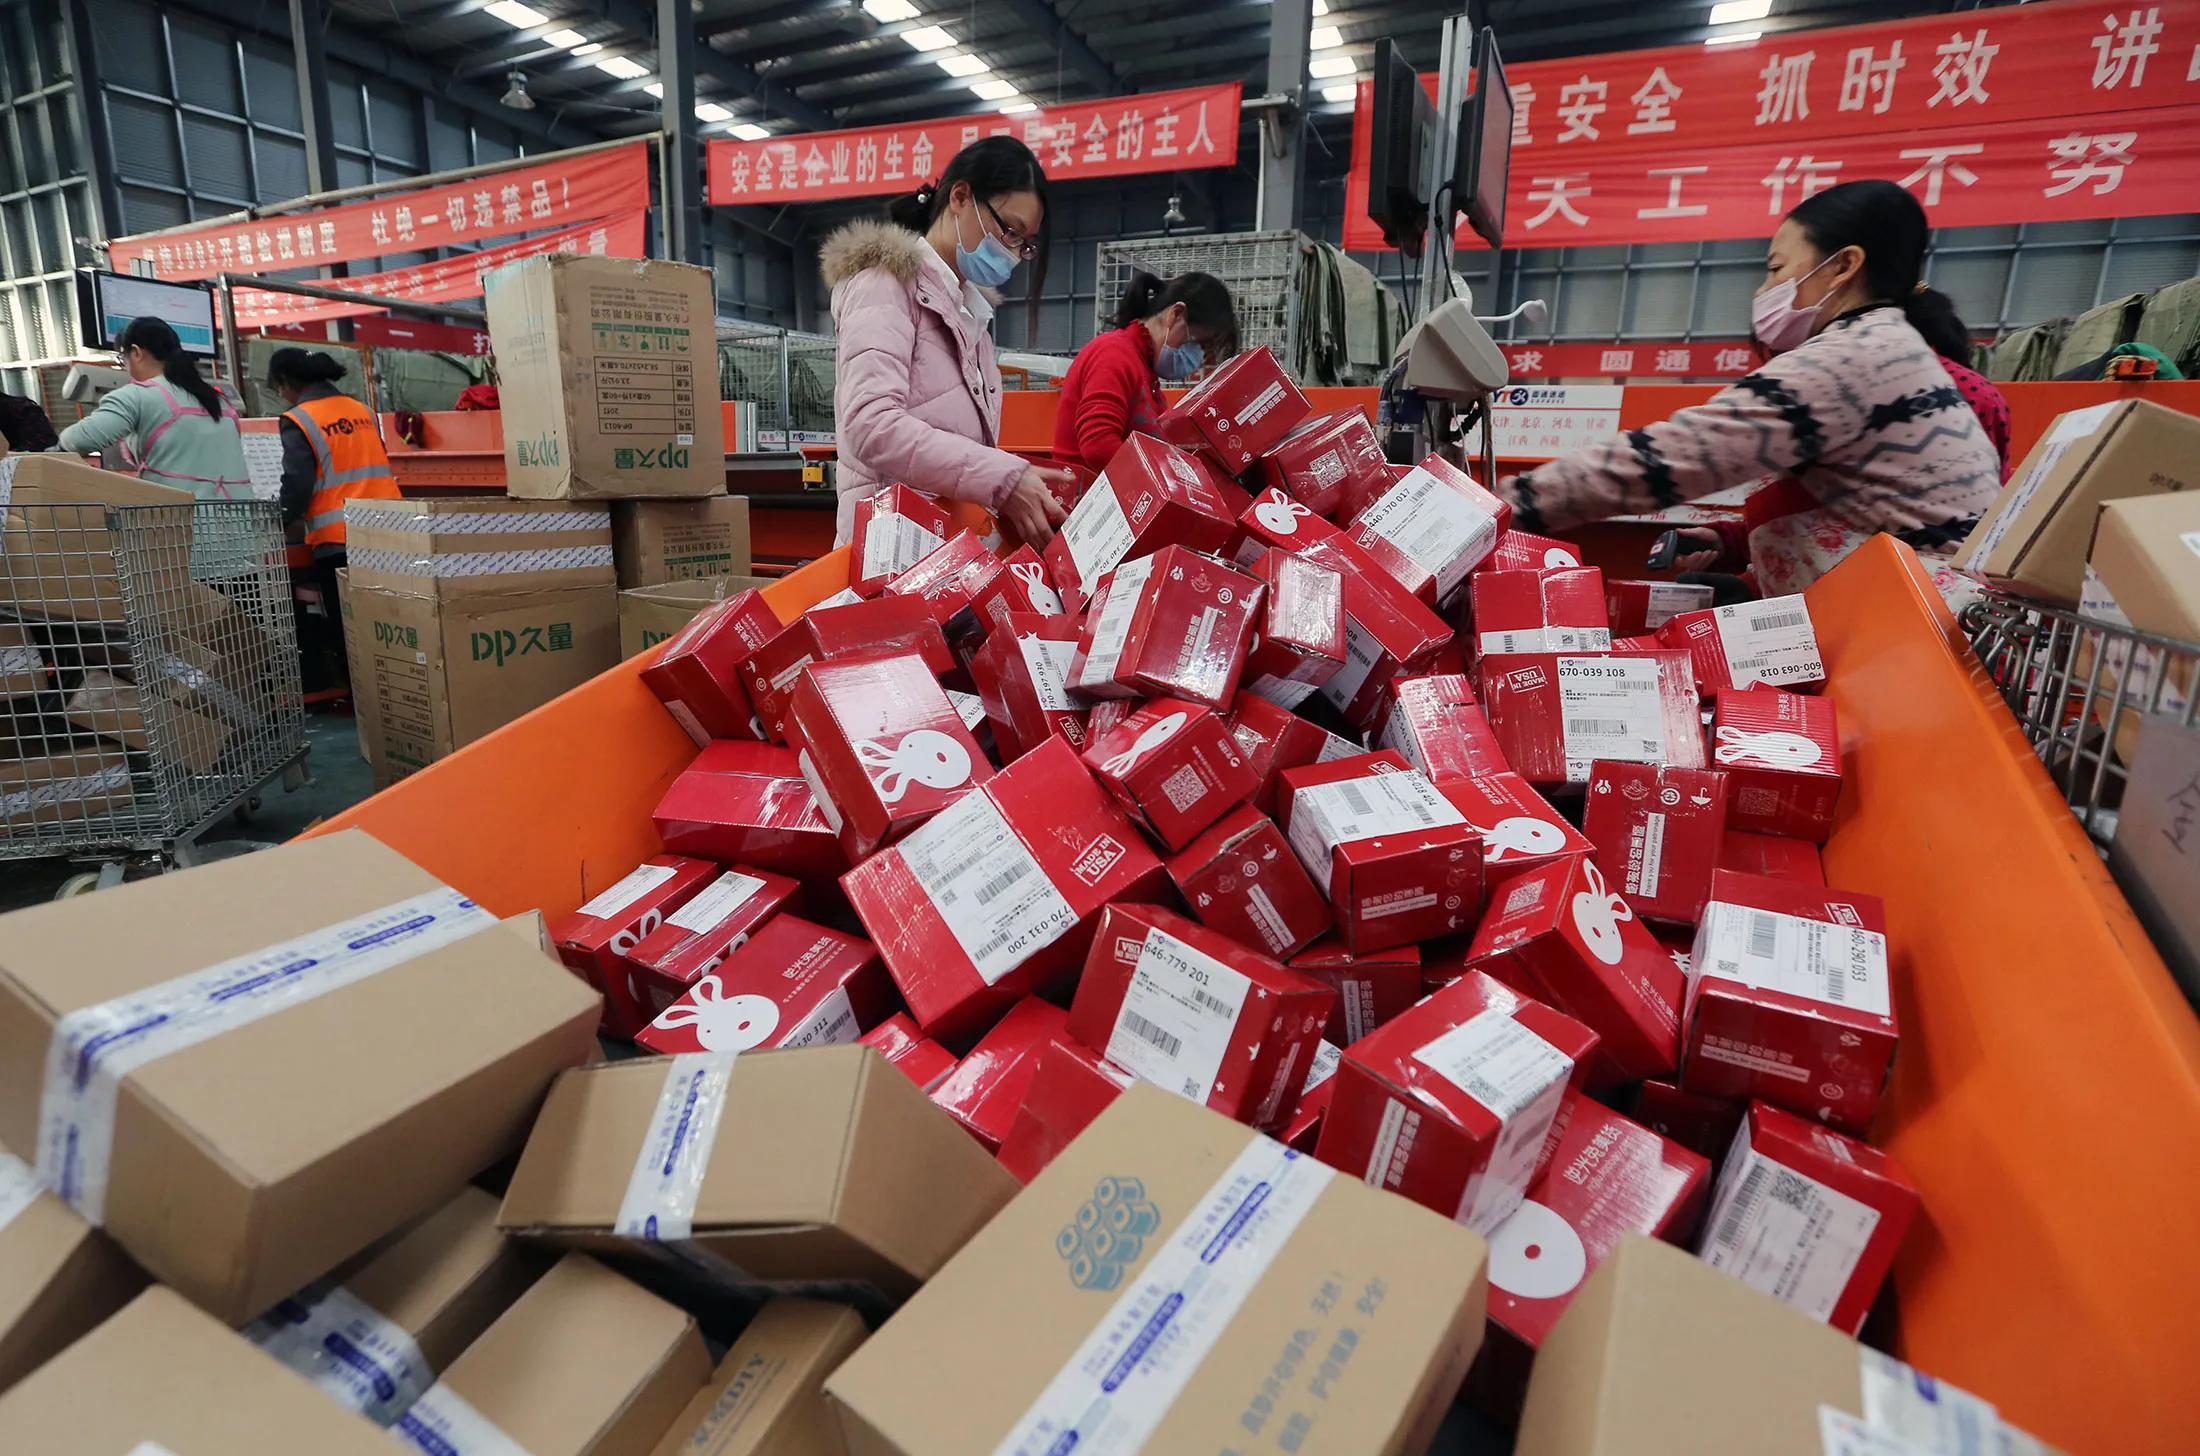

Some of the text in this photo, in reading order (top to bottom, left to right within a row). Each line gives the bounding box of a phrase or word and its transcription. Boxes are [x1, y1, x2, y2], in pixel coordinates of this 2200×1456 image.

[1754, 28, 2001, 127] 抓时效
[2091, 7, 2200, 91] 讲
[731, 101, 1215, 195] 安全是企业的生命 是安全的主人
[1455, 130, 2138, 231] 天工作不努
[1511, 349, 1750, 373] 求 圆通使
[1367, 488, 1412, 528] 440-370 017
[1559, 668, 1626, 678] 670-039 108
[1760, 661, 1822, 678] 600-063 018
[1424, 792, 1439, 808] 404
[1074, 850, 1100, 876] MADE
[1087, 848, 1115, 877] USA
[1007, 906, 1072, 956] 770-031 200
[1144, 942, 1210, 987] 646-779 201
[812, 1017, 829, 1035] 311
[1562, 1123, 1624, 1186] 逆光兔美货
